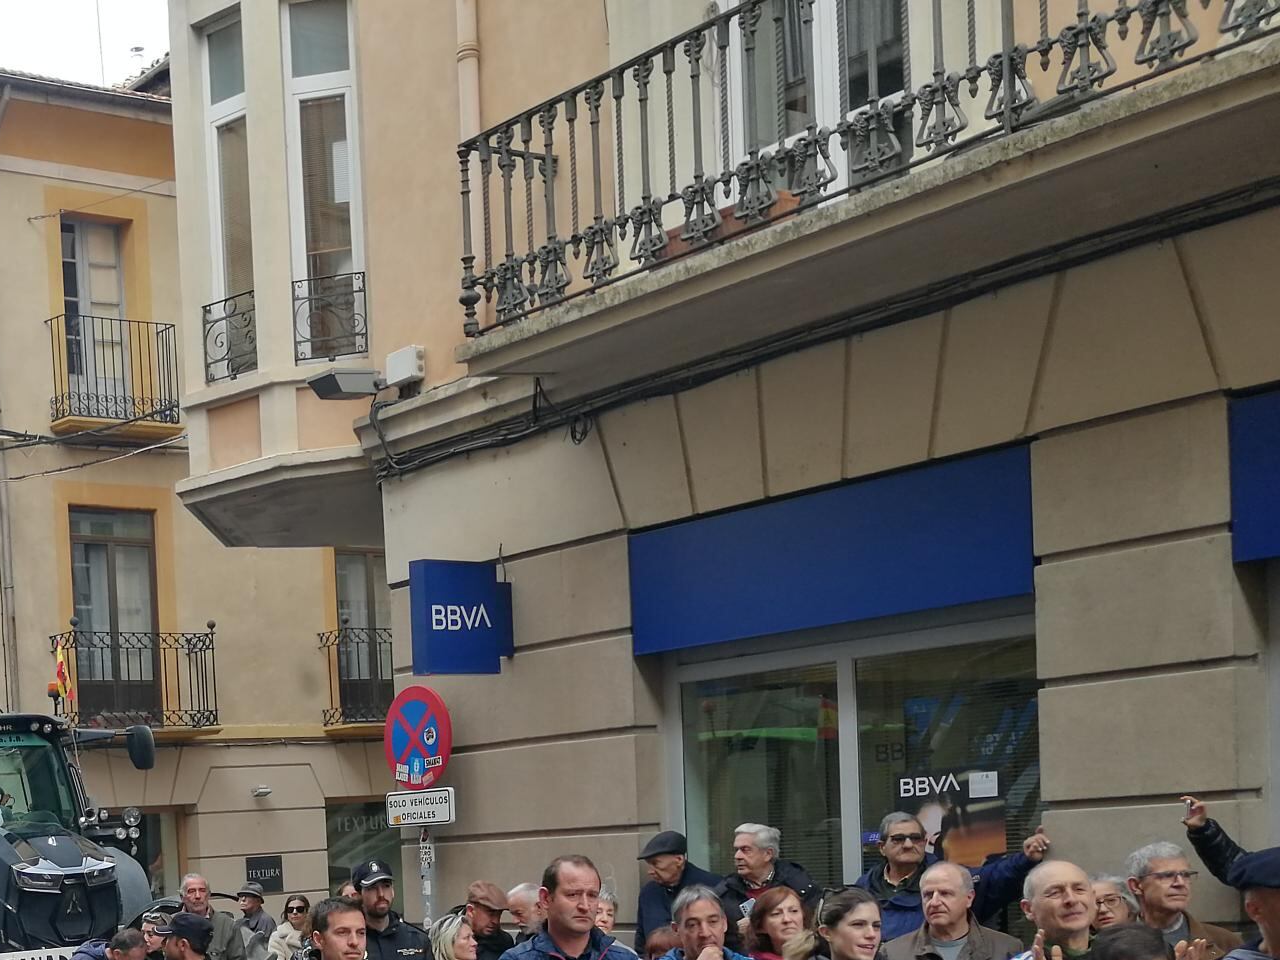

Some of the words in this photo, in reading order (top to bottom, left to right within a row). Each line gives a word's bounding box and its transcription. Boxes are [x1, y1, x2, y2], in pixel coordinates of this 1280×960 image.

[431, 603, 492, 631] BBVA
[900, 773, 960, 798] BBVA
[389, 799, 406, 809] SOLO
[336, 815, 388, 832] TEXTUR
[402, 810, 436, 821] OFICIALES
